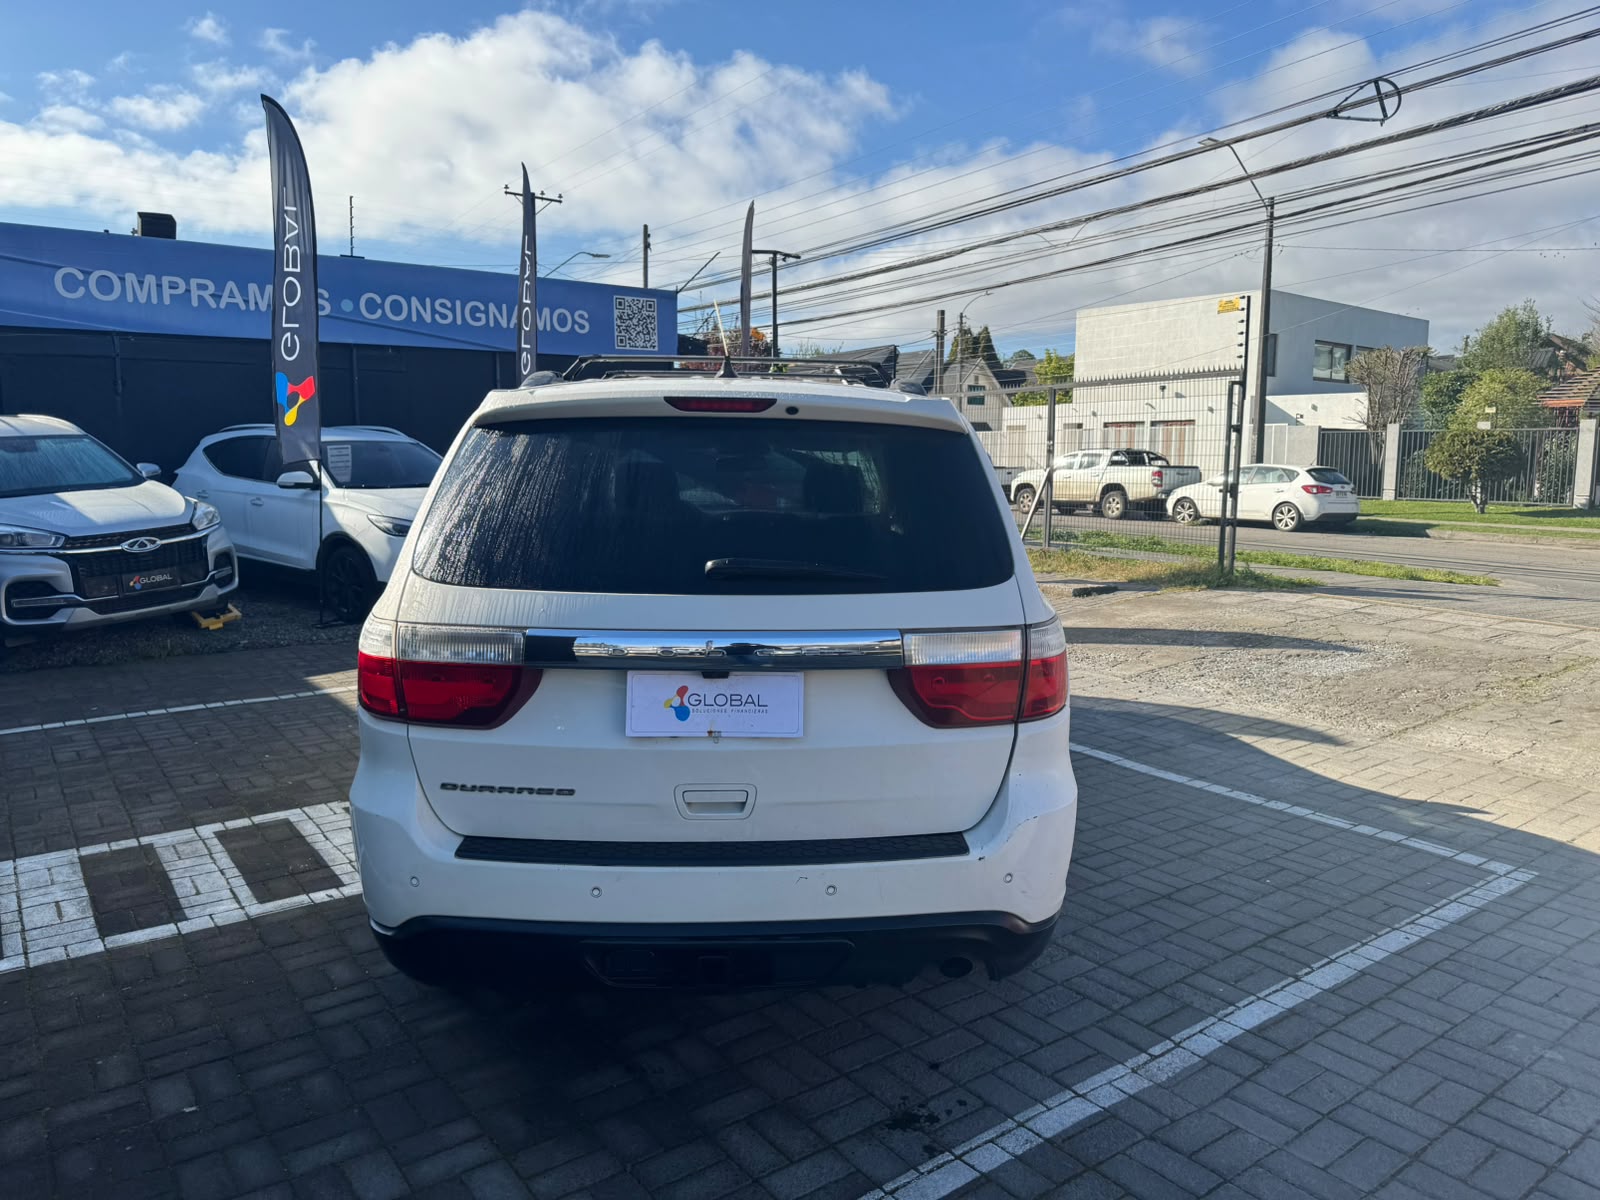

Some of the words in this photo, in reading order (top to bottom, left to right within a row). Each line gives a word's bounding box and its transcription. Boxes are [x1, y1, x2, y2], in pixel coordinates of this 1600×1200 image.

[54, 267, 332, 316] COMPRAMS
[139, 573, 174, 585] GLOBAL
[687, 692, 769, 708] GLOBAL
[440, 782, 576, 797] DURANGO
